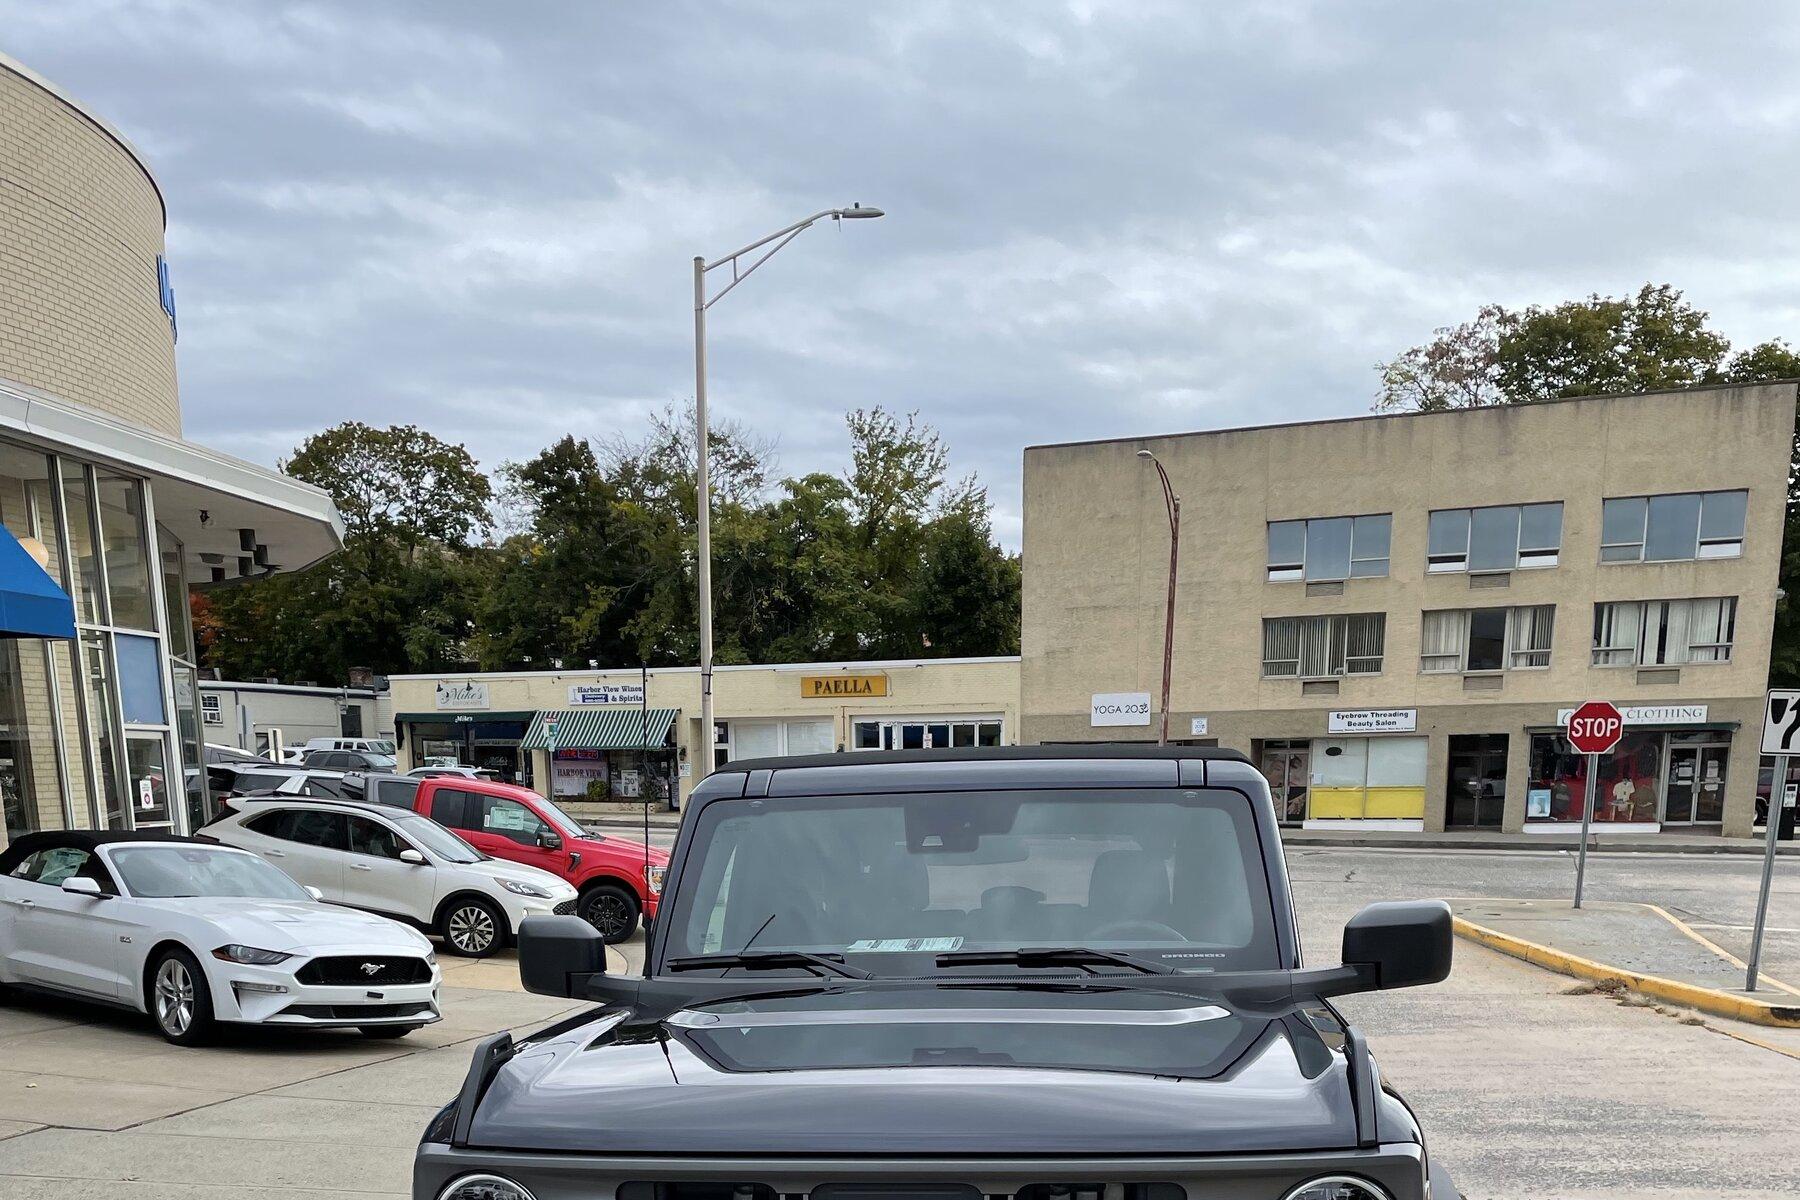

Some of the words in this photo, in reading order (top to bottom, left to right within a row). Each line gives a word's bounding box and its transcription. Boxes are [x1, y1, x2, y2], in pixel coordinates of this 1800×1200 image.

[814, 680, 872, 695] PAELLA
[441, 687, 484, 705] Mike's
[619, 694, 643, 703] Spirits
[1093, 705, 1122, 715] YOGA
[1370, 711, 1409, 719] Threading
[1627, 708, 1702, 720] CLOTHING
[1347, 720, 1374, 728] Beauty
[1571, 718, 1619, 738] STOP
[557, 768, 584, 778] HARBOR
[586, 768, 603, 778] VIEW
